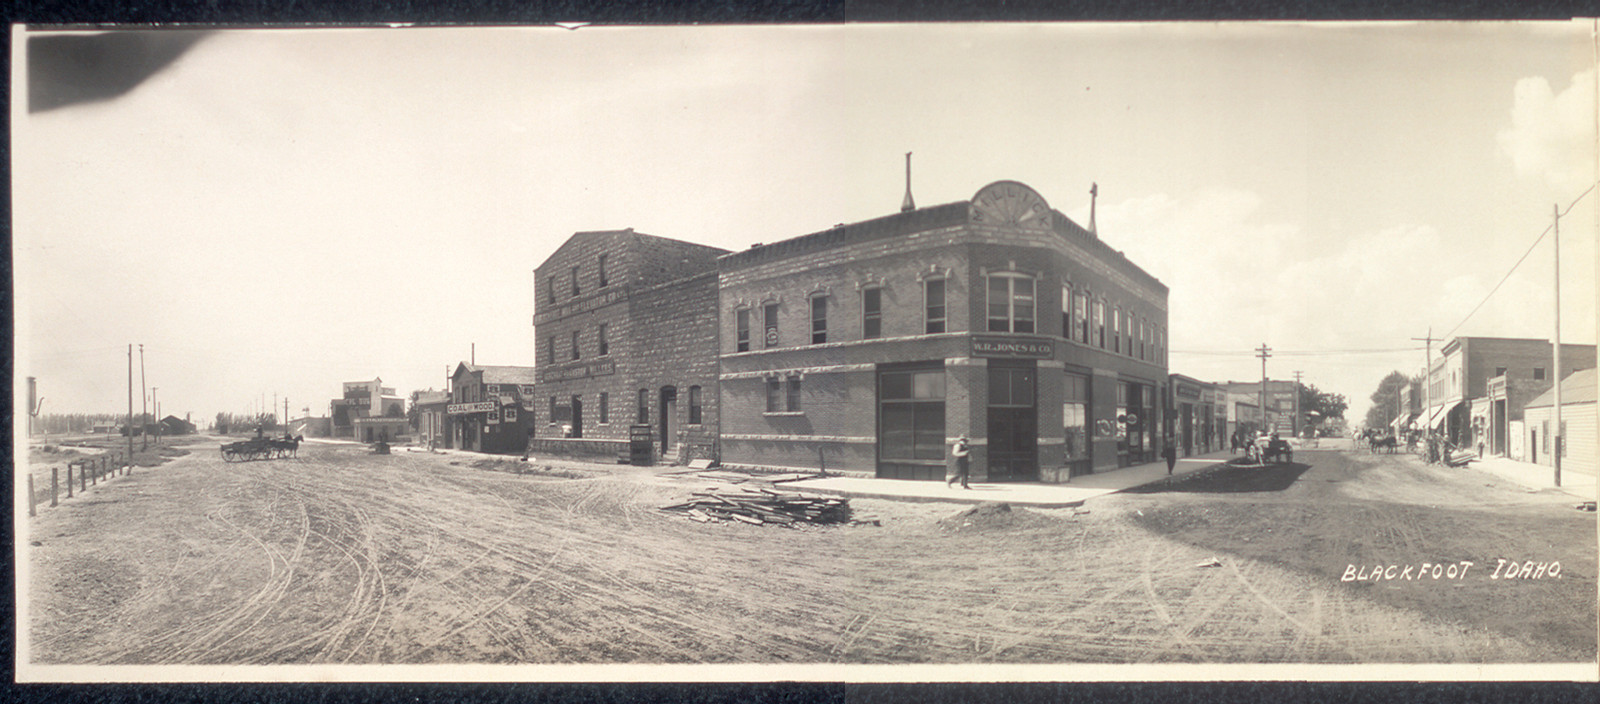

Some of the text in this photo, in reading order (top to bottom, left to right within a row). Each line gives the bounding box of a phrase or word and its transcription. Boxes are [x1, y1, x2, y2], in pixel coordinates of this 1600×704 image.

[972, 187, 1049, 226] MILLICK
[448, 404, 468, 413] COAL
[474, 402, 493, 412] WOOD
